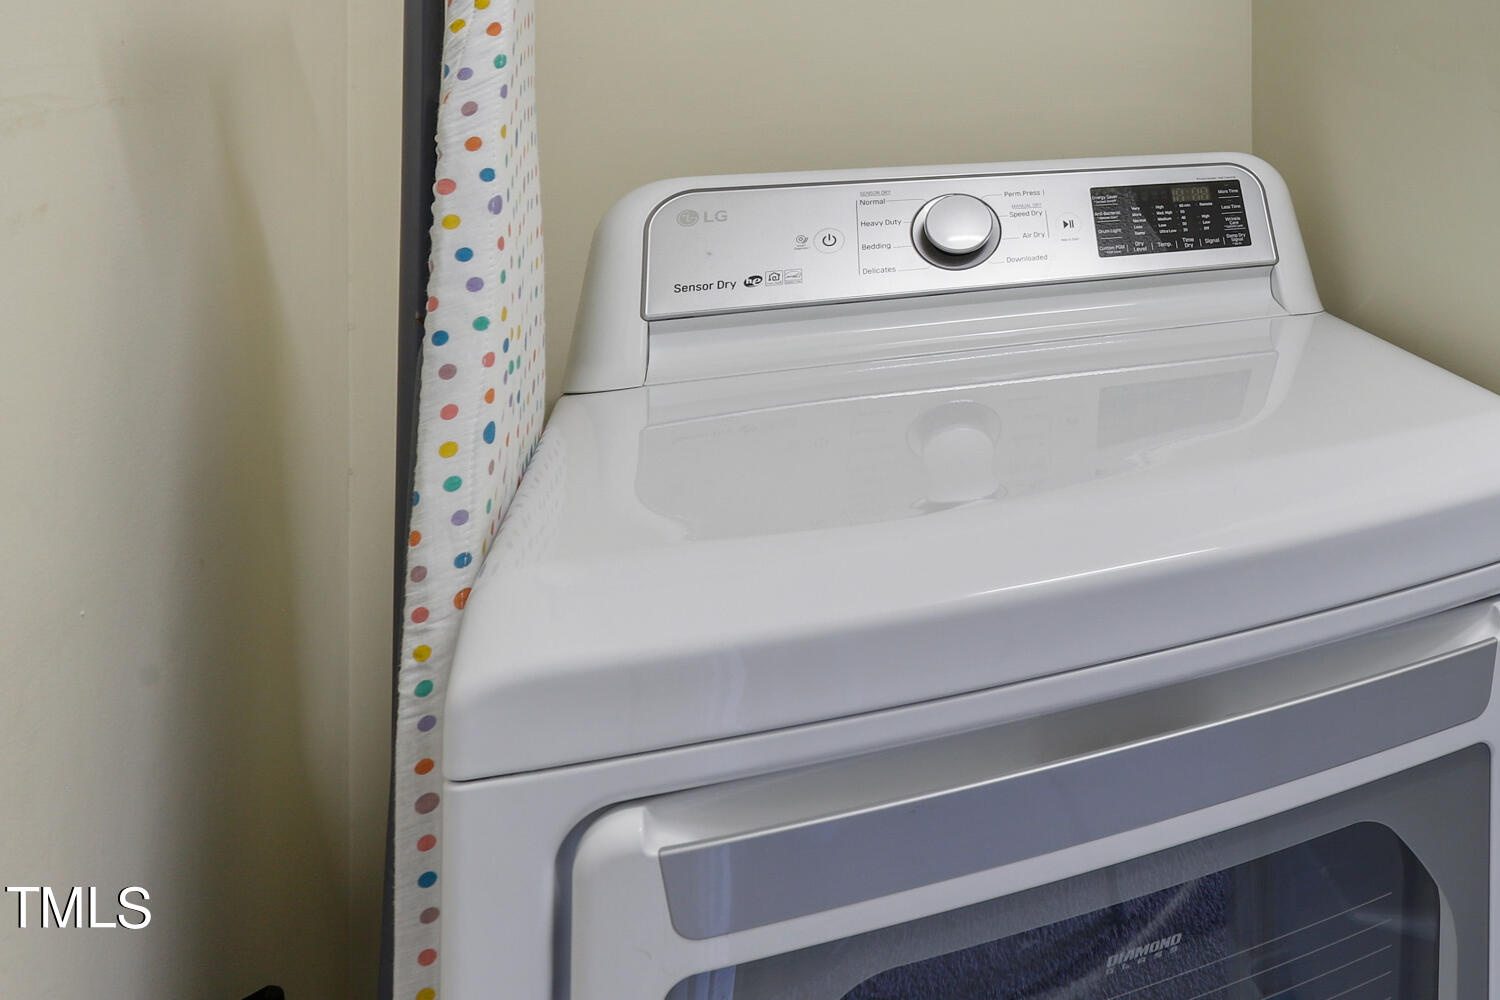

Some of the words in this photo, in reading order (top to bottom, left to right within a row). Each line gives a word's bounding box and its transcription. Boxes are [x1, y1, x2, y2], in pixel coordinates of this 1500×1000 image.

[703, 210, 728, 222] LG
[860, 220, 884, 228] Heavy
[884, 219, 902, 227] Duty
[862, 243, 891, 251] Bedding
[1006, 254, 1048, 263] Downloaded
[862, 266, 896, 275] Delicates
[673, 282, 714, 293] Sensor
[717, 280, 737, 290] Dry
[1106, 932, 1182, 968] DIAMOND
